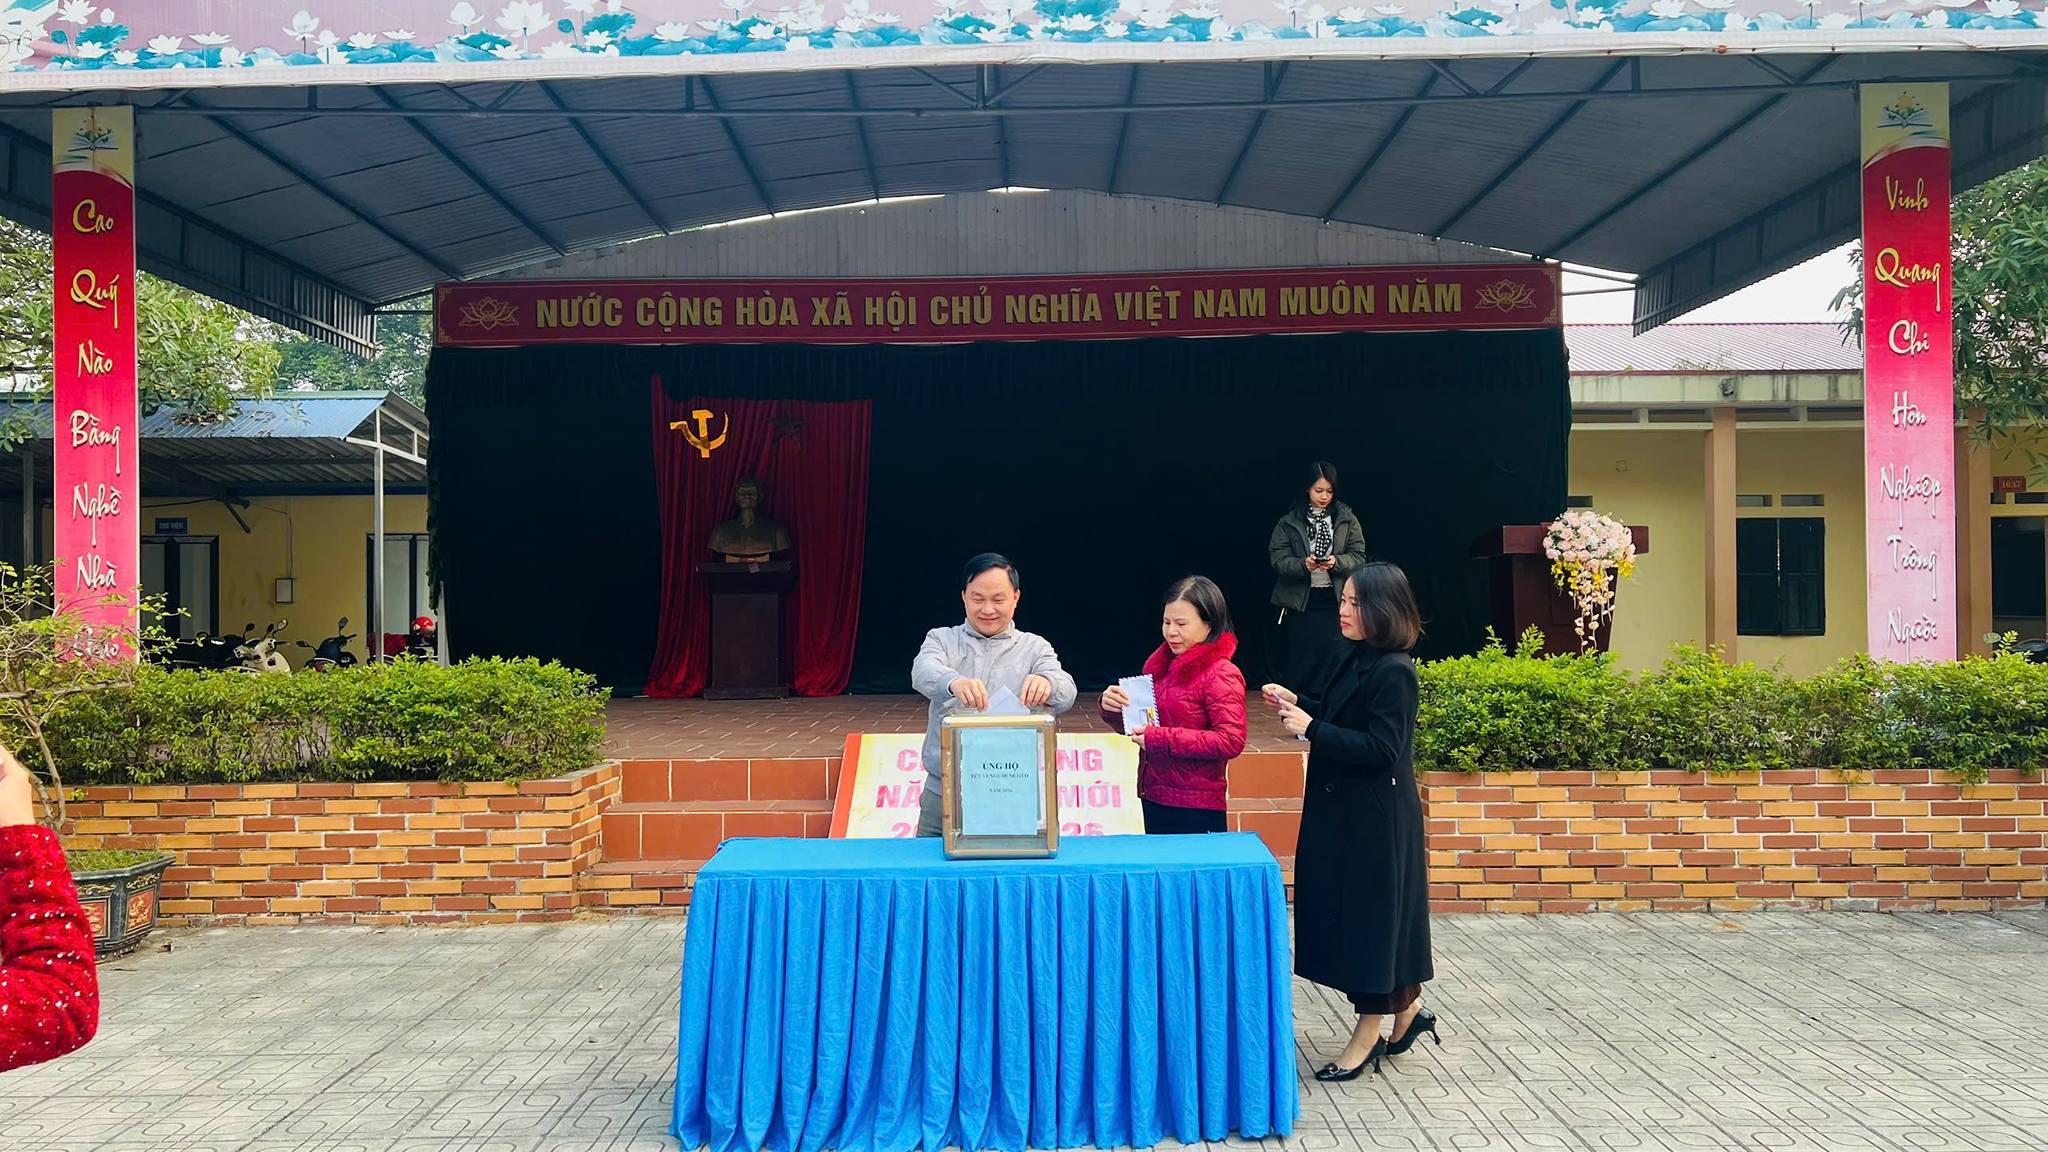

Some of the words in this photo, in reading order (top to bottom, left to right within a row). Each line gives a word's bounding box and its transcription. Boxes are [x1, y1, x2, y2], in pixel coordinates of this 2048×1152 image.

[72, 198, 115, 235] Cao
[1885, 175, 1930, 212] Vinh
[70, 268, 120, 330] Quý
[536, 291, 624, 329] NƯỚC
[635, 291, 723, 332] CỘNG
[735, 290, 800, 327] HÒA
[811, 291, 852, 327] XÃ
[865, 291, 918, 332] HỘI
[929, 285, 993, 326] CHỦ
[1004, 287, 1103, 324] NGHĨA
[1114, 285, 1182, 327] VIỆT
[1193, 287, 1267, 320] NAM
[1279, 279, 1376, 317] MUÔN
[1387, 276, 1463, 314] NĂM
[1874, 247, 1942, 312] Quang
[77, 338, 114, 379] Nào
[1888, 319, 1931, 356] Chi
[69, 409, 122, 474] Bằng
[73, 481, 122, 546] Nghề
[1880, 463, 1943, 530] Nghiệp
[76, 552, 118, 591] Nhà
[1887, 534, 1938, 601] Trồng
[1888, 607, 1938, 664] Người
[875, 780, 922, 808] NĂ
[1057, 780, 1122, 808] MỚI
